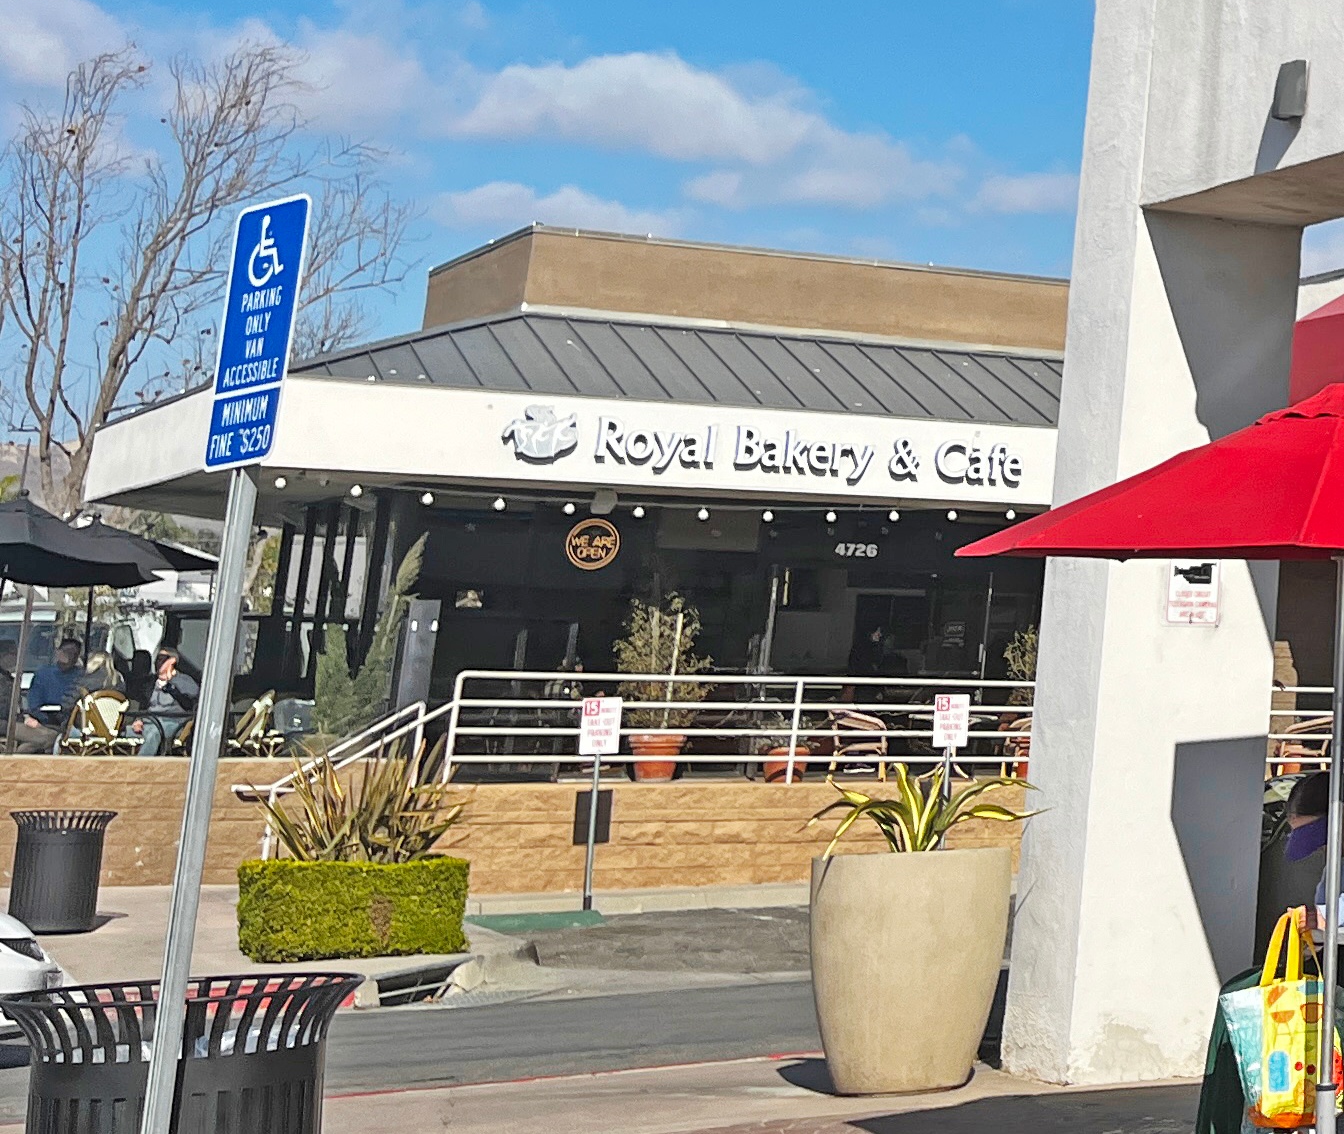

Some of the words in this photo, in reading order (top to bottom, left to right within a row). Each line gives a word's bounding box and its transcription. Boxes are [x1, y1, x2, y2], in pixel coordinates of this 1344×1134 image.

[240, 285, 282, 313] PARKING
[244, 311, 272, 336] ONLY
[245, 337, 265, 359] VAN
[222, 357, 279, 388] ACCESSIBLE
[221, 395, 269, 428] MINIMUM
[208, 431, 232, 460] FINE
[240, 424, 270, 456] $250
[594, 416, 719, 475] Royal
[733, 425, 875, 486] Bakery
[888, 437, 921, 482] &
[935, 439, 1023, 488] Cafe
[571, 535, 590, 547] WE
[592, 535, 616, 548] ARE
[576, 546, 607, 559] OPEN
[834, 543, 878, 558] 4726
[587, 701, 600, 716] 15
[937, 697, 950, 711] 15
